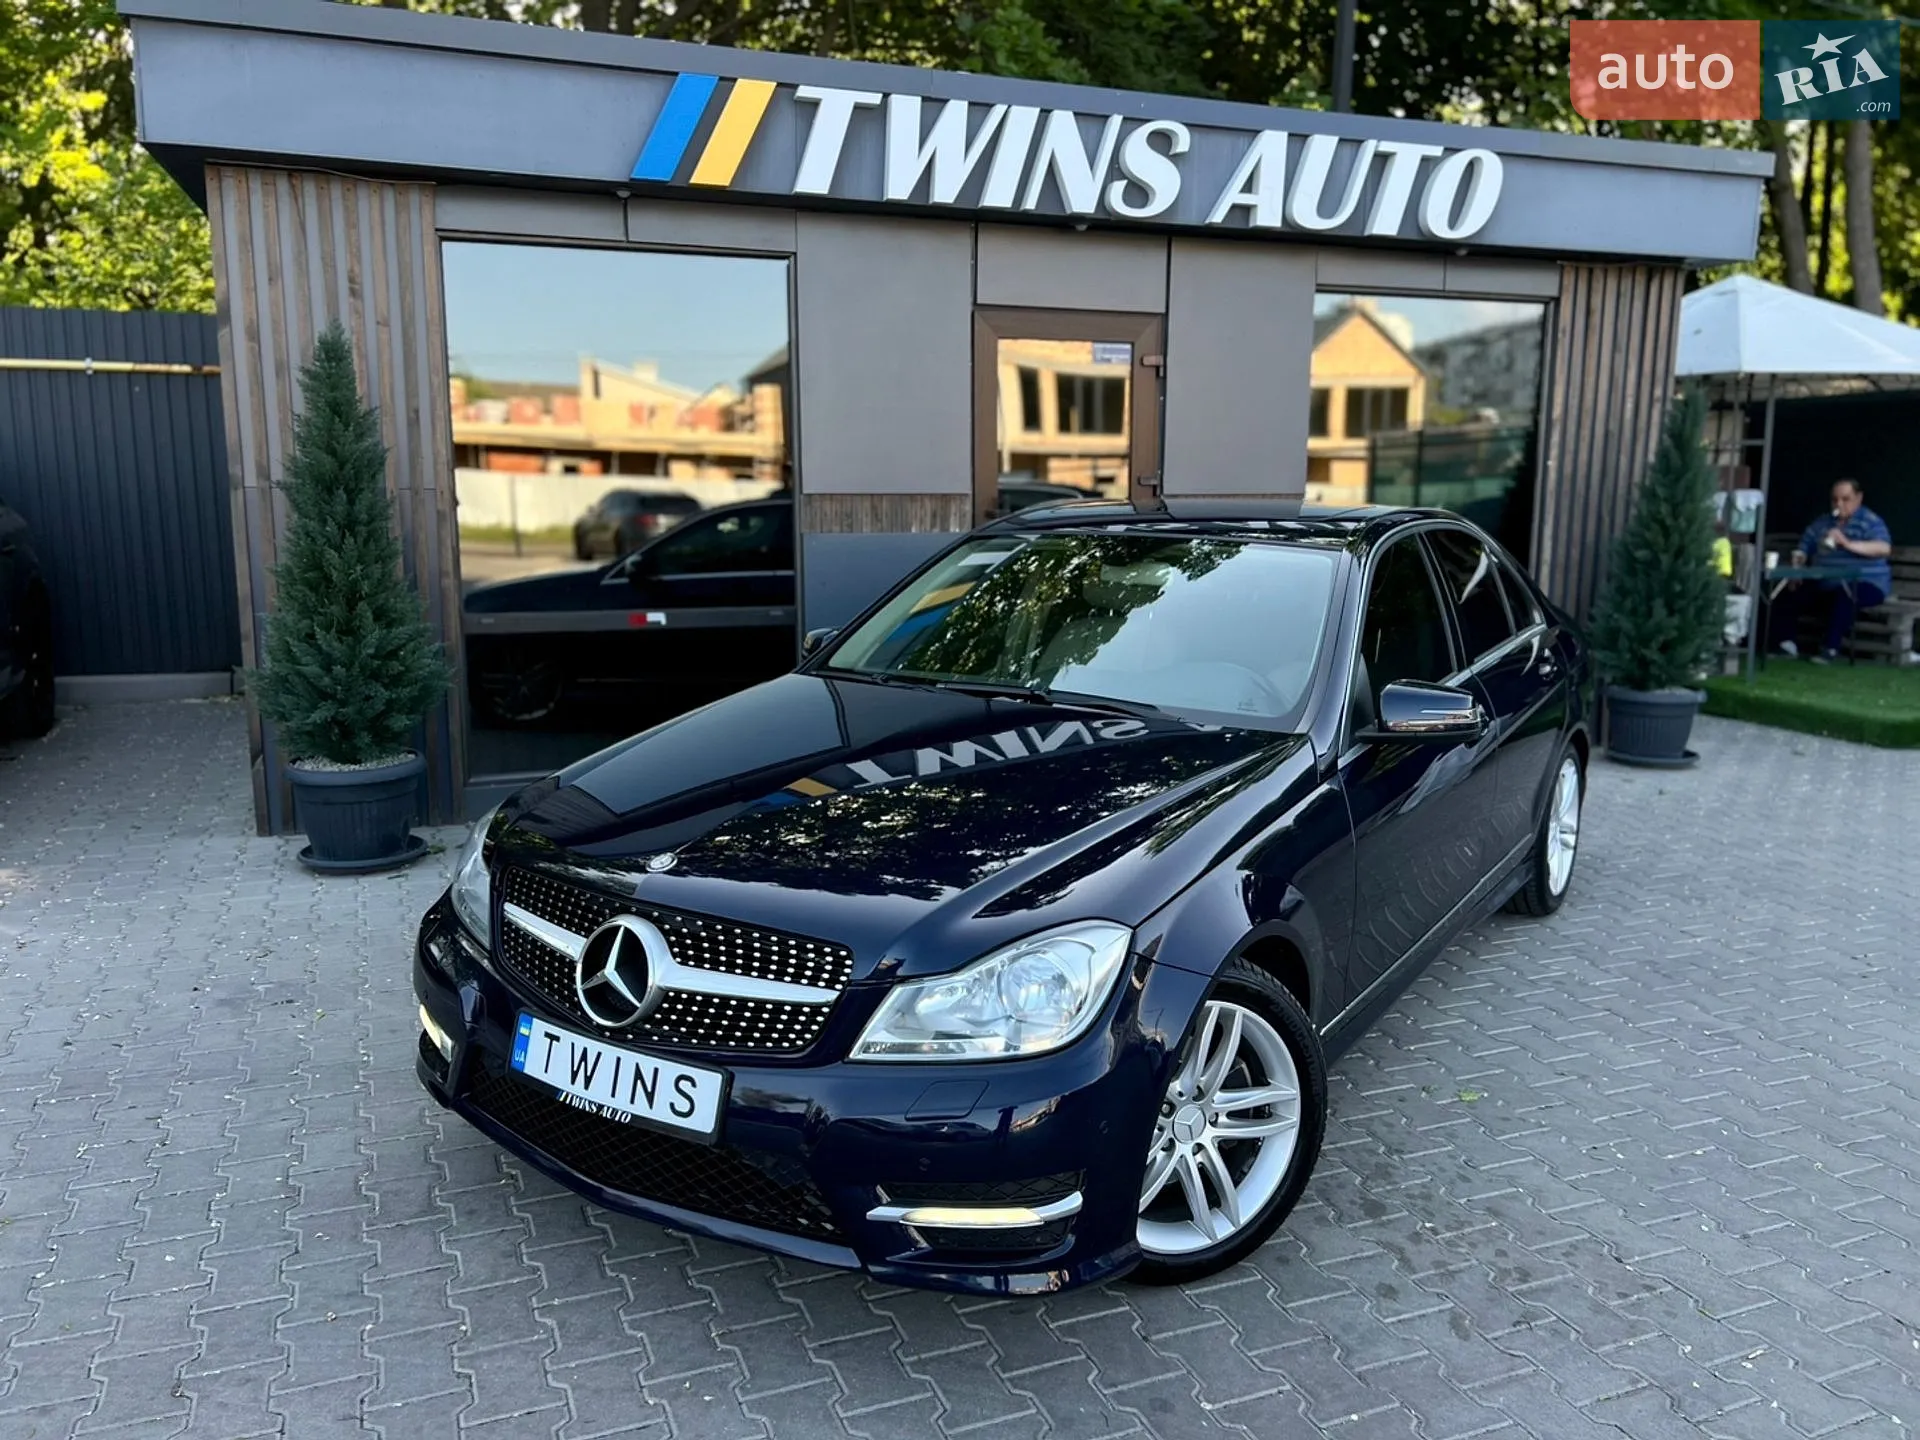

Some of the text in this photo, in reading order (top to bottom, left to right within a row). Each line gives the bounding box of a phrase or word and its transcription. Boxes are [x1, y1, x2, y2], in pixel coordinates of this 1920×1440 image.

[792, 85, 1504, 239] TWINS AUTO
[543, 1031, 698, 1118] TWINS
[565, 1092, 632, 1124] TWINS AUTO
